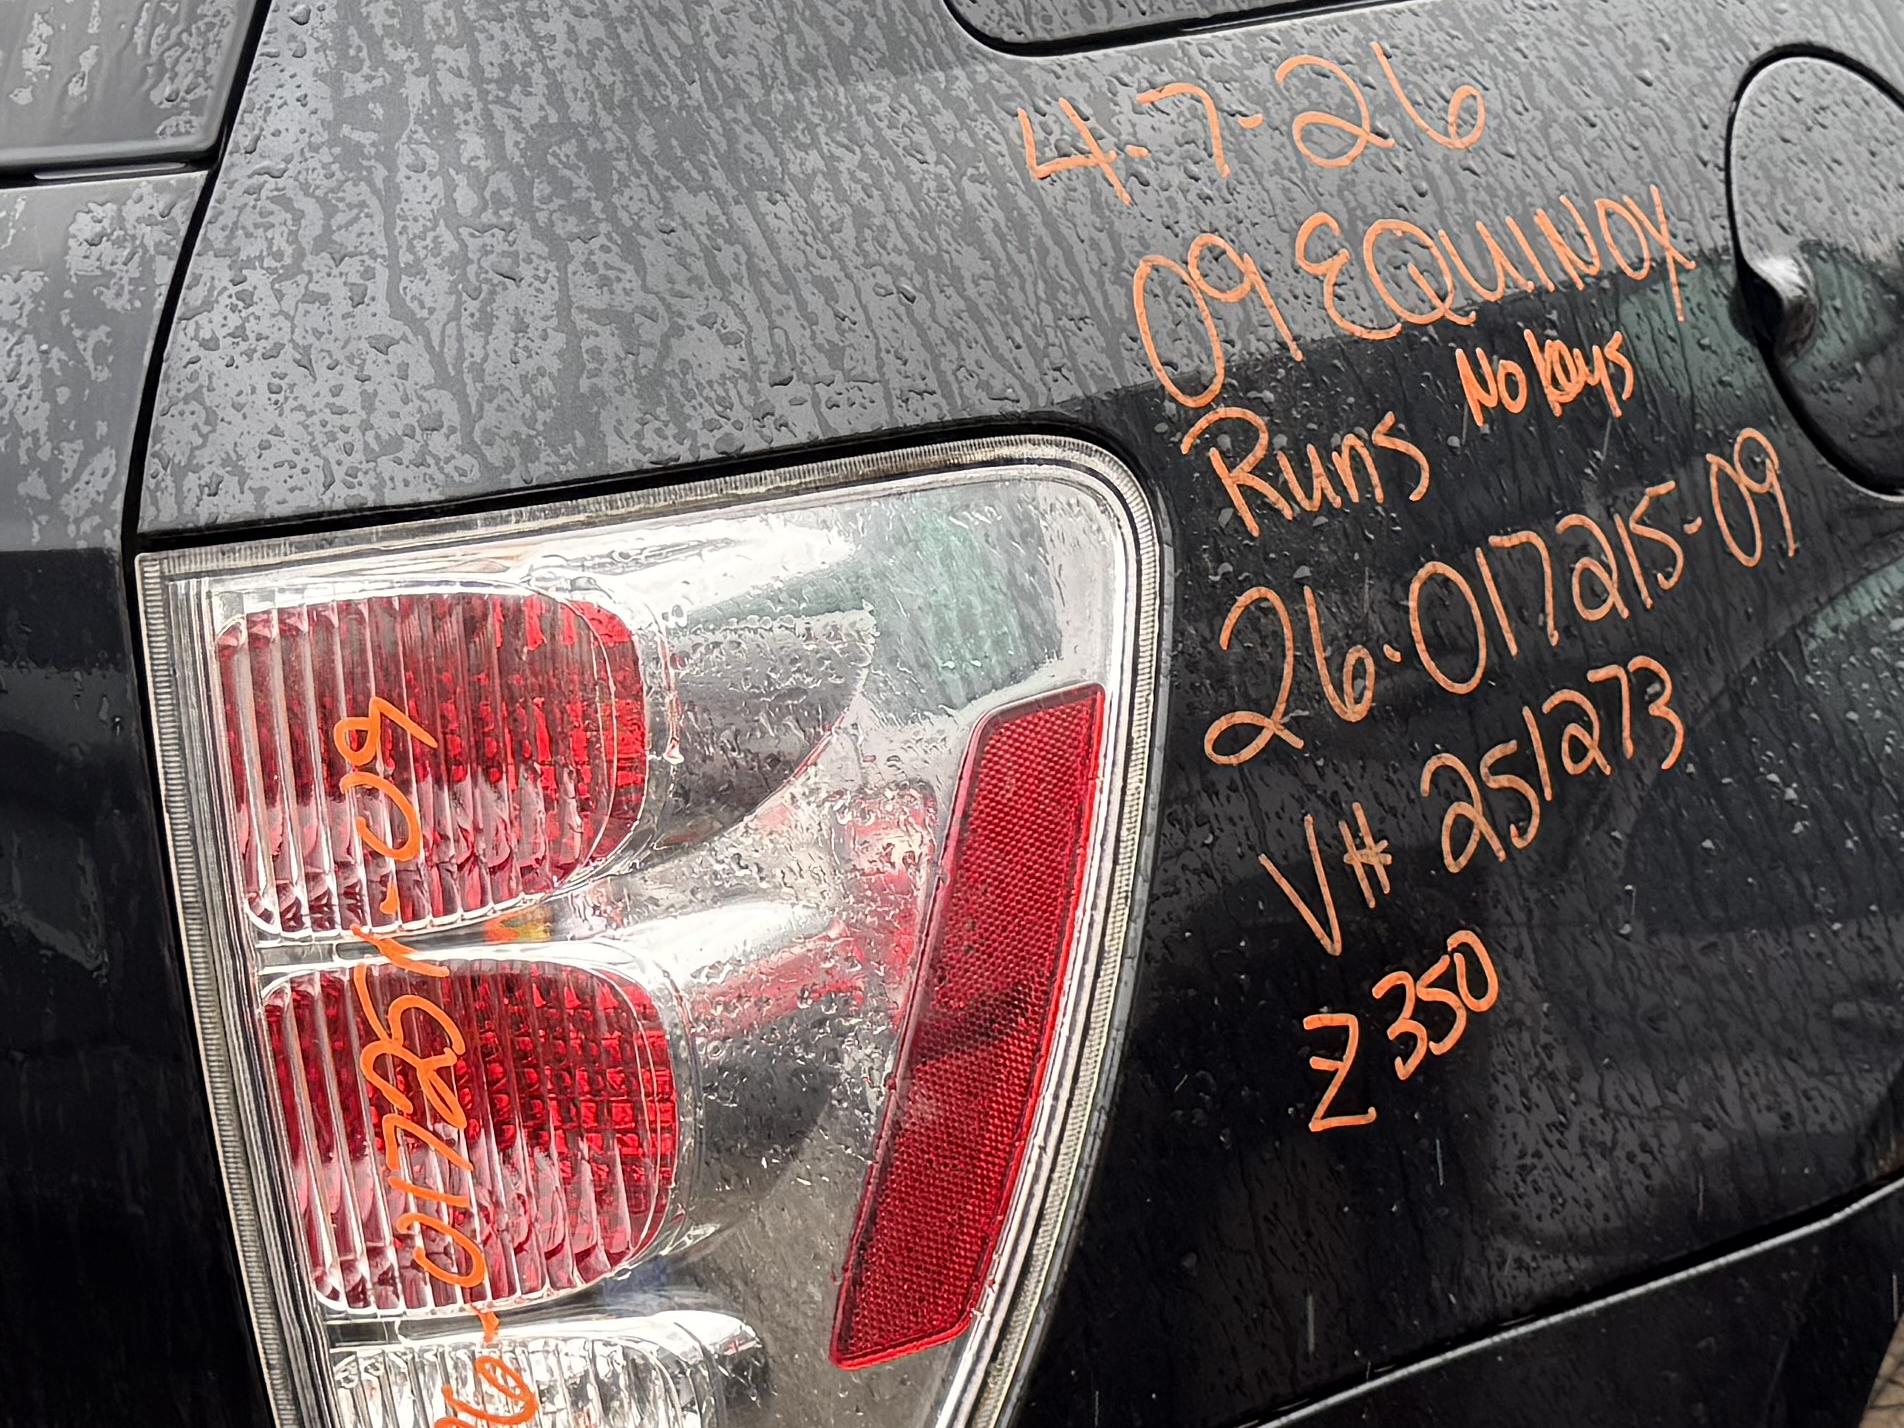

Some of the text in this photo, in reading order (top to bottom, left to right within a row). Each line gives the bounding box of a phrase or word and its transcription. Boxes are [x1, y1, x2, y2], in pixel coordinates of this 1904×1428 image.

[1017, 40, 1485, 205] 4-7-26
[1135, 185, 1697, 408] 09 EQUINOX
[1182, 405, 1430, 535] Runs
[1421, 655, 1685, 874] 251273
